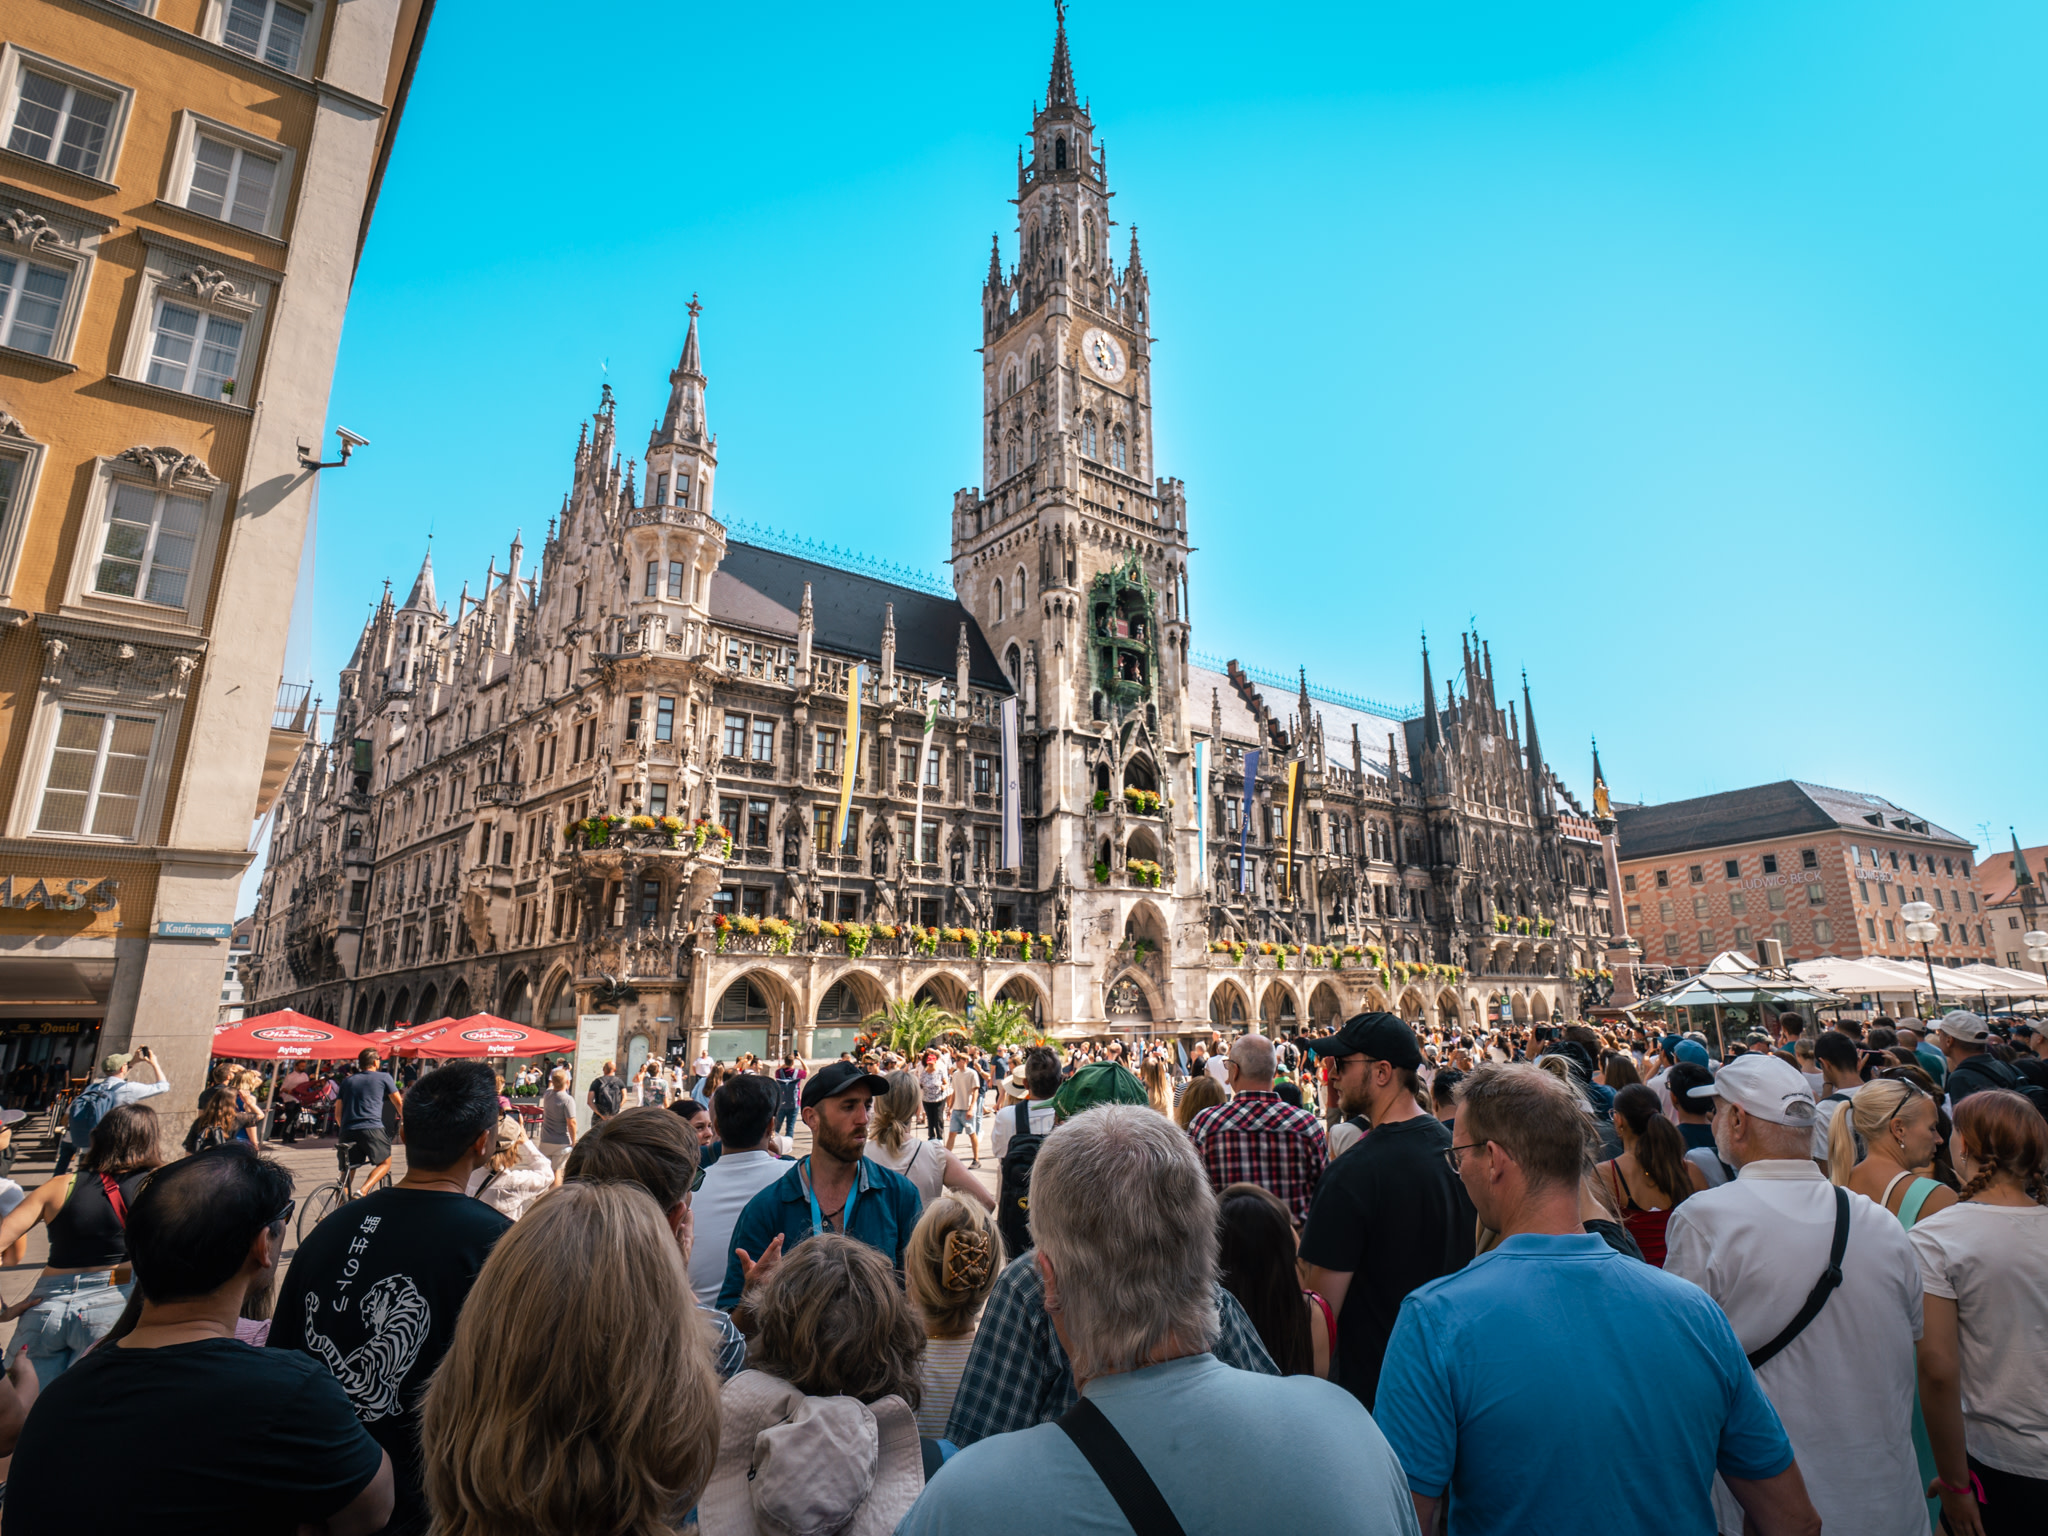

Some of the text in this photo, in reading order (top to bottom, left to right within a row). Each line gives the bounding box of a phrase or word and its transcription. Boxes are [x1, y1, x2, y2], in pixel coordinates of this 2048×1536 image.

[1740, 870, 1823, 890] LUDWIG BECK
[1854, 868, 1893, 882] LUDWIG BECK
[165, 923, 225, 936] Kaufingetr.
[968, 992, 975, 1004] S
[1502, 996, 1509, 1004] S
[1502, 1005, 1510, 1014] U
[40, 1022, 80, 1034] Donisl
[277, 1046, 312, 1055] Ayinger
[487, 1045, 515, 1053] Ayinger
[332, 1214, 382, 1312] 野生のトラ
